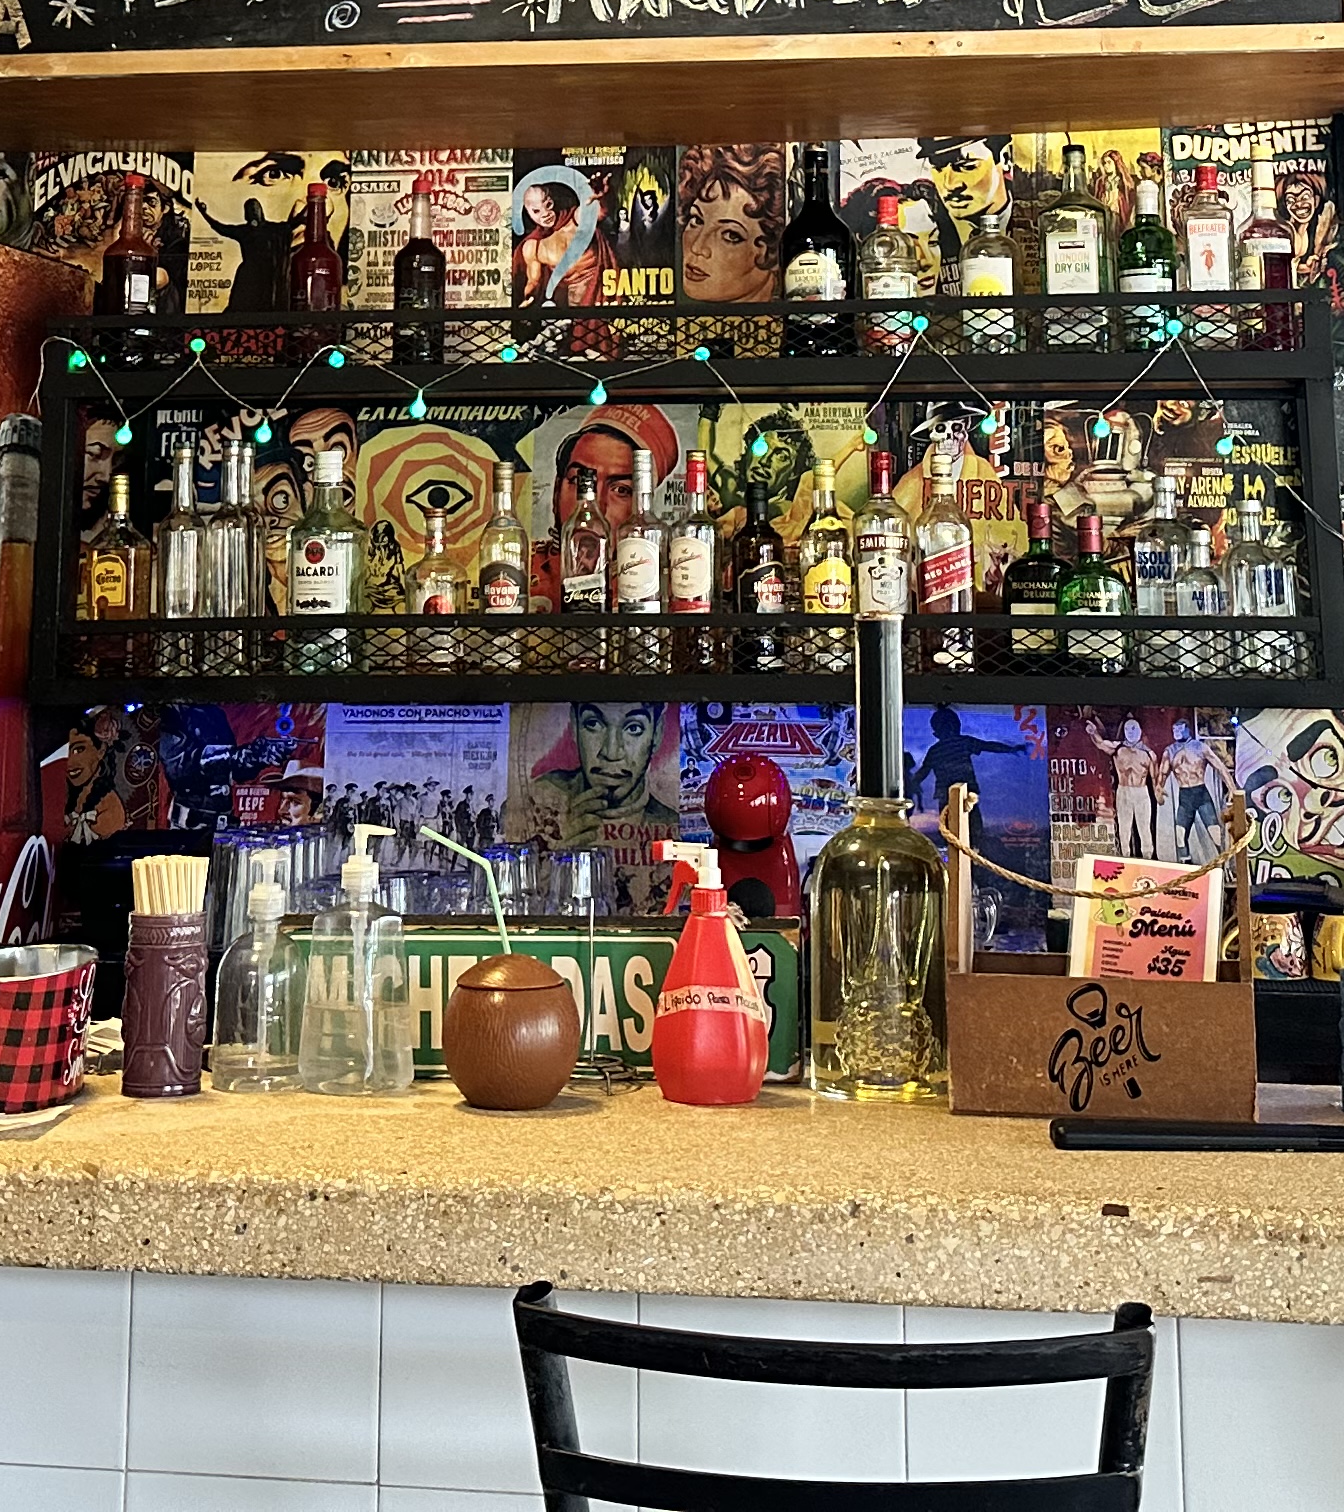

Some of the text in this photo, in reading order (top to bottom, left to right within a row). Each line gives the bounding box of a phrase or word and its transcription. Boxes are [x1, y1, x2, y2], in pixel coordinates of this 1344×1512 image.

[351, 148, 514, 168] ANTASTICAMANI
[56, 150, 195, 207] VAGABUNDO
[351, 181, 400, 193] OSAKA
[367, 229, 409, 248] MISTIC
[190, 262, 222, 272] LOPEZ
[1054, 262, 1091, 274] DRY GIN
[186, 279, 232, 289] RANCISCO
[602, 267, 674, 297] SANTO
[604, 408, 642, 433] HOTEL
[1187, 495, 1227, 508] ALVARAD
[923, 568, 943, 581] RED
[490, 595, 513, 607] Club
[342, 707, 504, 719] VAMONOS CON PANCHO VILLA
[1050, 758, 1088, 776] ANTO
[1051, 776, 1075, 793] LUE
[238, 796, 265, 812] LEPE
[1050, 795, 1096, 812] EMON
[1051, 824, 1108, 842] RACULA
[1139, 906, 1183, 921] Paletas
[1128, 918, 1197, 939] Menú
[1160, 945, 1192, 958] Agua
[1146, 955, 1187, 977] $35
[309, 952, 655, 1054] MICHDAS
[1048, 1001, 1161, 1113] Beer
[1099, 1054, 1140, 1088] IS HERE
